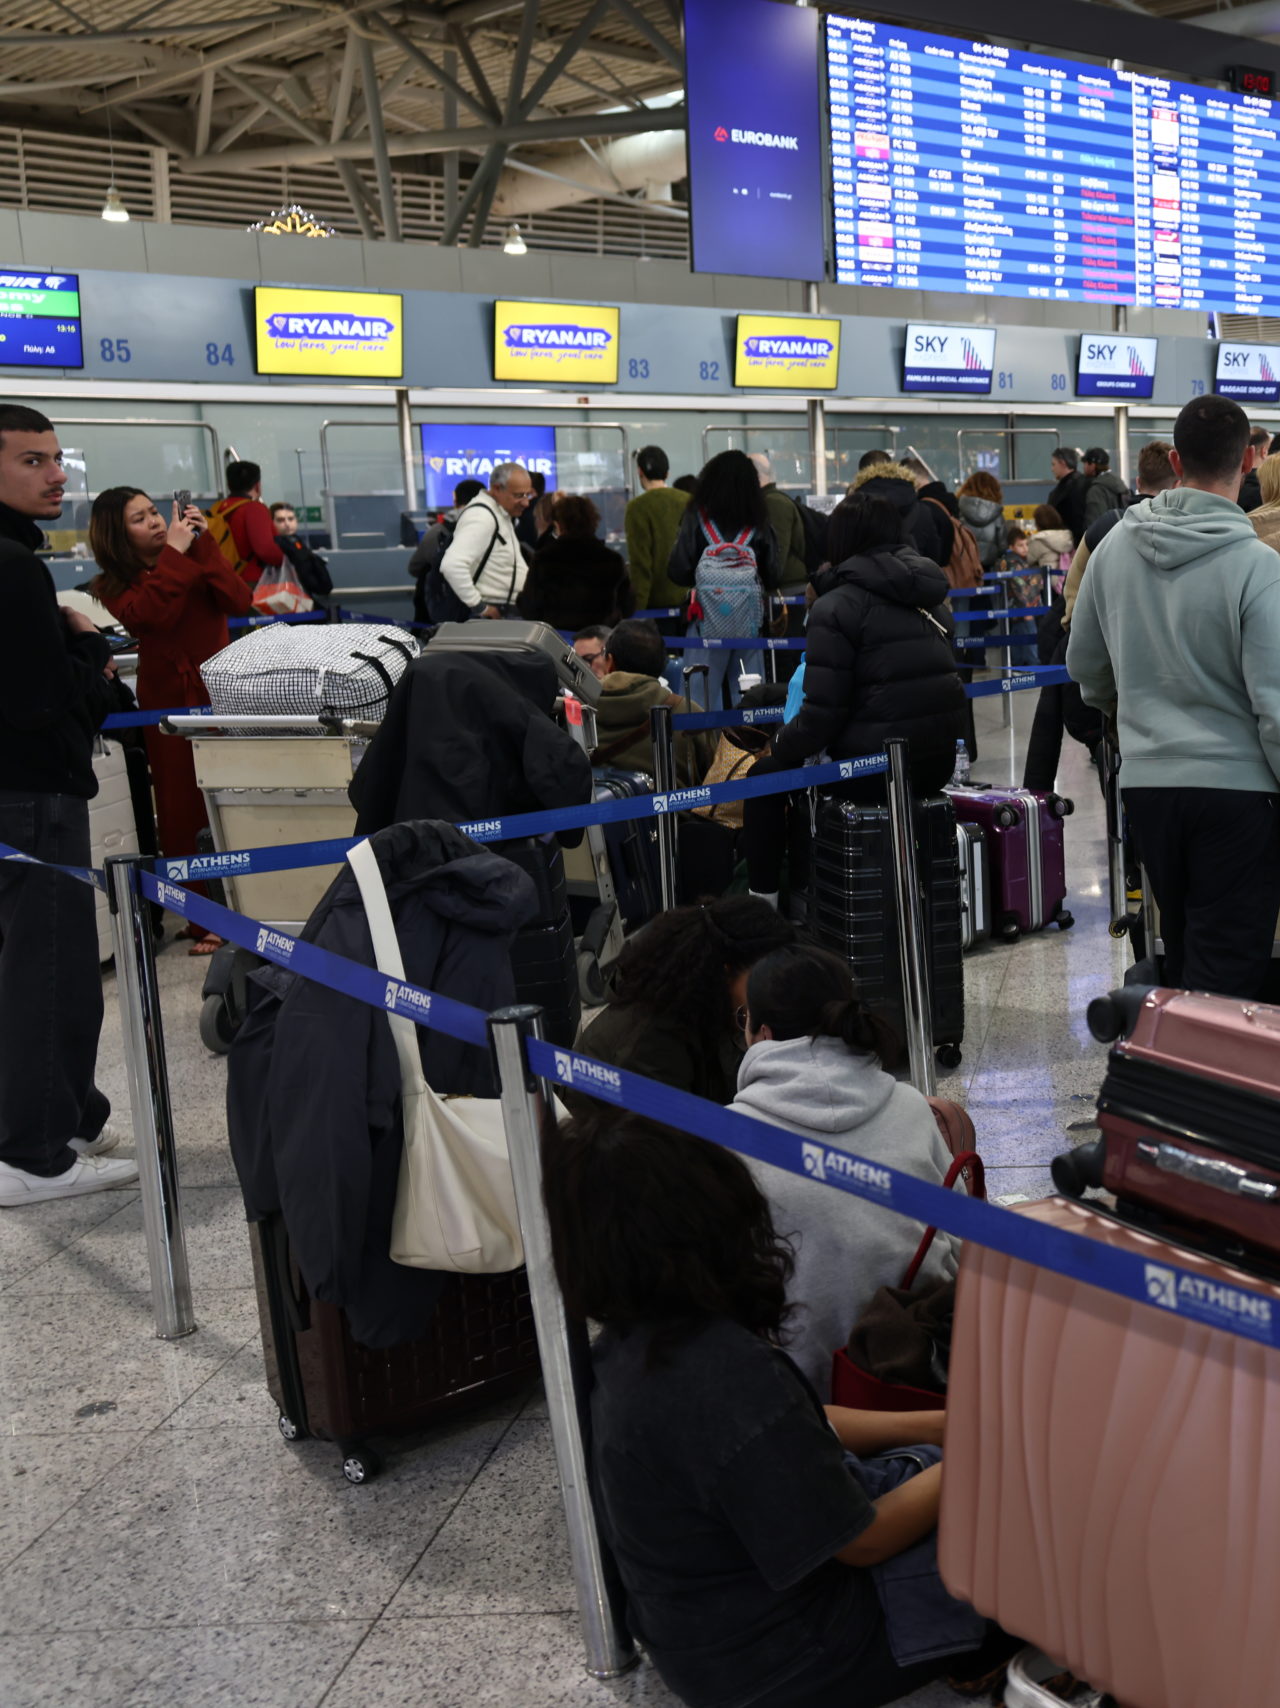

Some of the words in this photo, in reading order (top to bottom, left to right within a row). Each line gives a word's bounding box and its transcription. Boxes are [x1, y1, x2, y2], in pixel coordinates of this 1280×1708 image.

[731, 129, 798, 150] EUROBANK
[288, 318, 387, 337] RYANAIR
[522, 328, 606, 346] RYANAIR
[914, 336, 948, 353] SKY
[100, 338, 132, 363] 85
[206, 342, 235, 366] 84
[759, 340, 829, 355] RYANAIR
[1087, 344, 1117, 360] SKY
[1224, 352, 1250, 367] SKY
[628, 358, 650, 379] 83
[700, 361, 719, 380] 82
[906, 374, 931, 382] FAMILIES
[999, 372, 1014, 389] 81
[1051, 374, 1066, 390] 80
[1191, 379, 1204, 395] 79
[1220, 385, 1247, 393] BAGGAGE
[1011, 675, 1036, 684] ATHENS
[754, 707, 785, 716] ATHENS
[853, 754, 888, 769] ATHENS
[669, 787, 711, 802] ATHENS
[189, 864, 228, 873] INTERNATIONAL
[190, 853, 250, 869] ATHENS
[164, 885, 186, 903] ATHENS
[266, 931, 295, 953] ATHENS
[397, 985, 431, 1009] ATHENS
[572, 1057, 621, 1086] ATHENS
[825, 1151, 892, 1189] ATHENS
[1178, 1275, 1271, 1321] ATHENS
